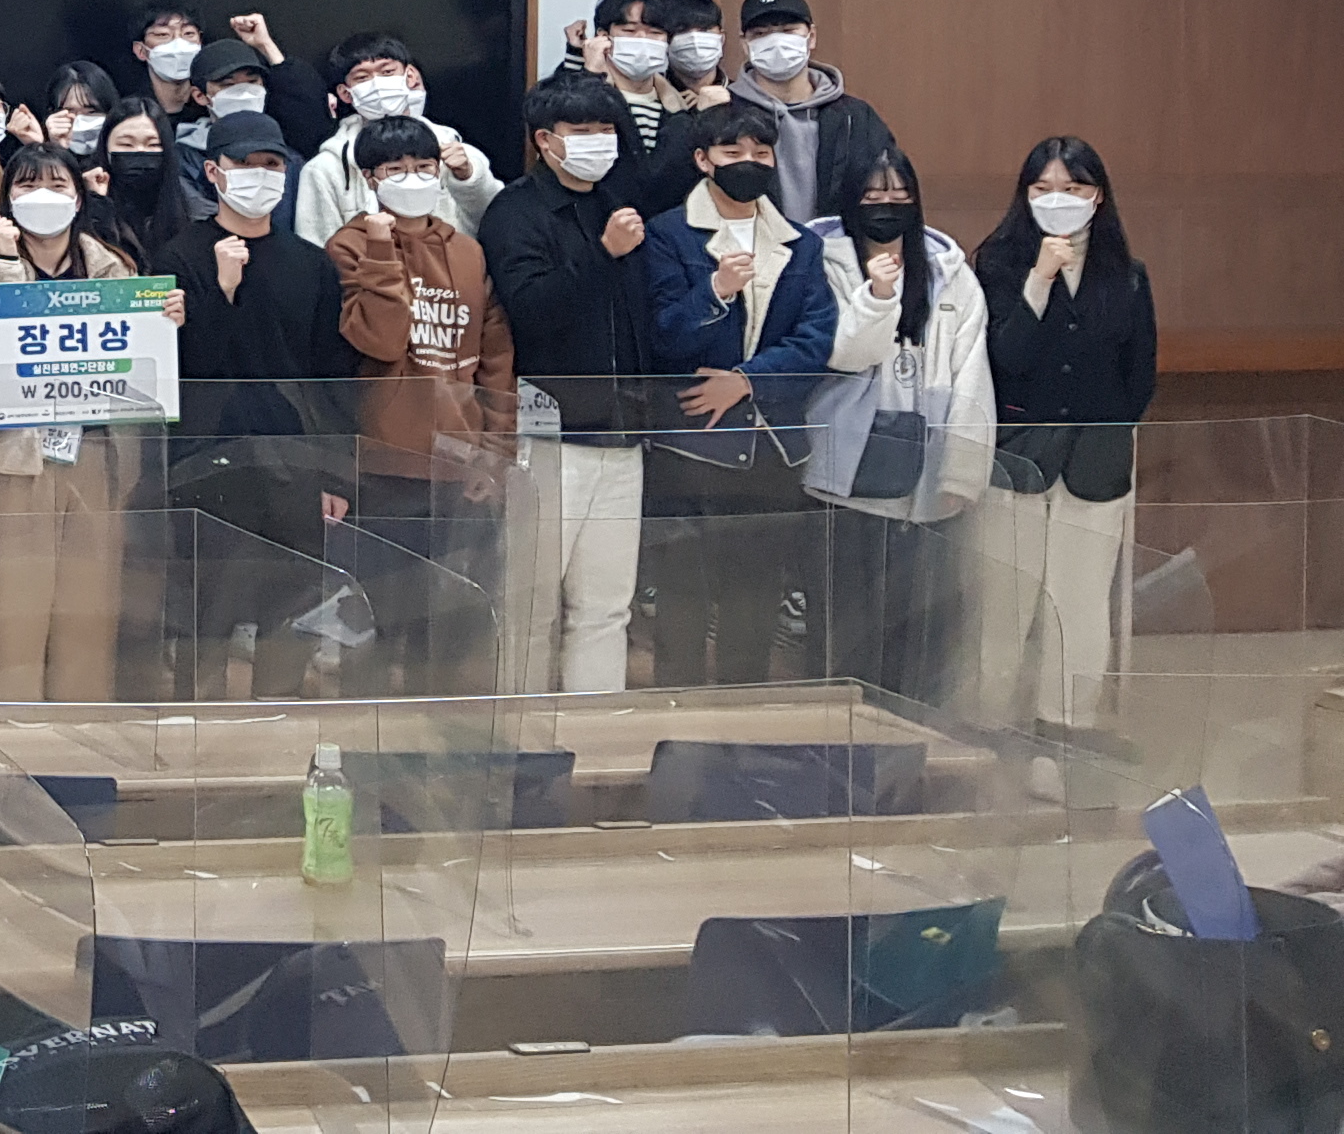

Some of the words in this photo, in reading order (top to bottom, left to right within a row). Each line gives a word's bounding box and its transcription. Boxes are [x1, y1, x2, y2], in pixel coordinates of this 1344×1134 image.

[134, 289, 167, 299] X-Corp
[17, 319, 132, 357] 장려상
[43, 378, 128, 402] 200,000
